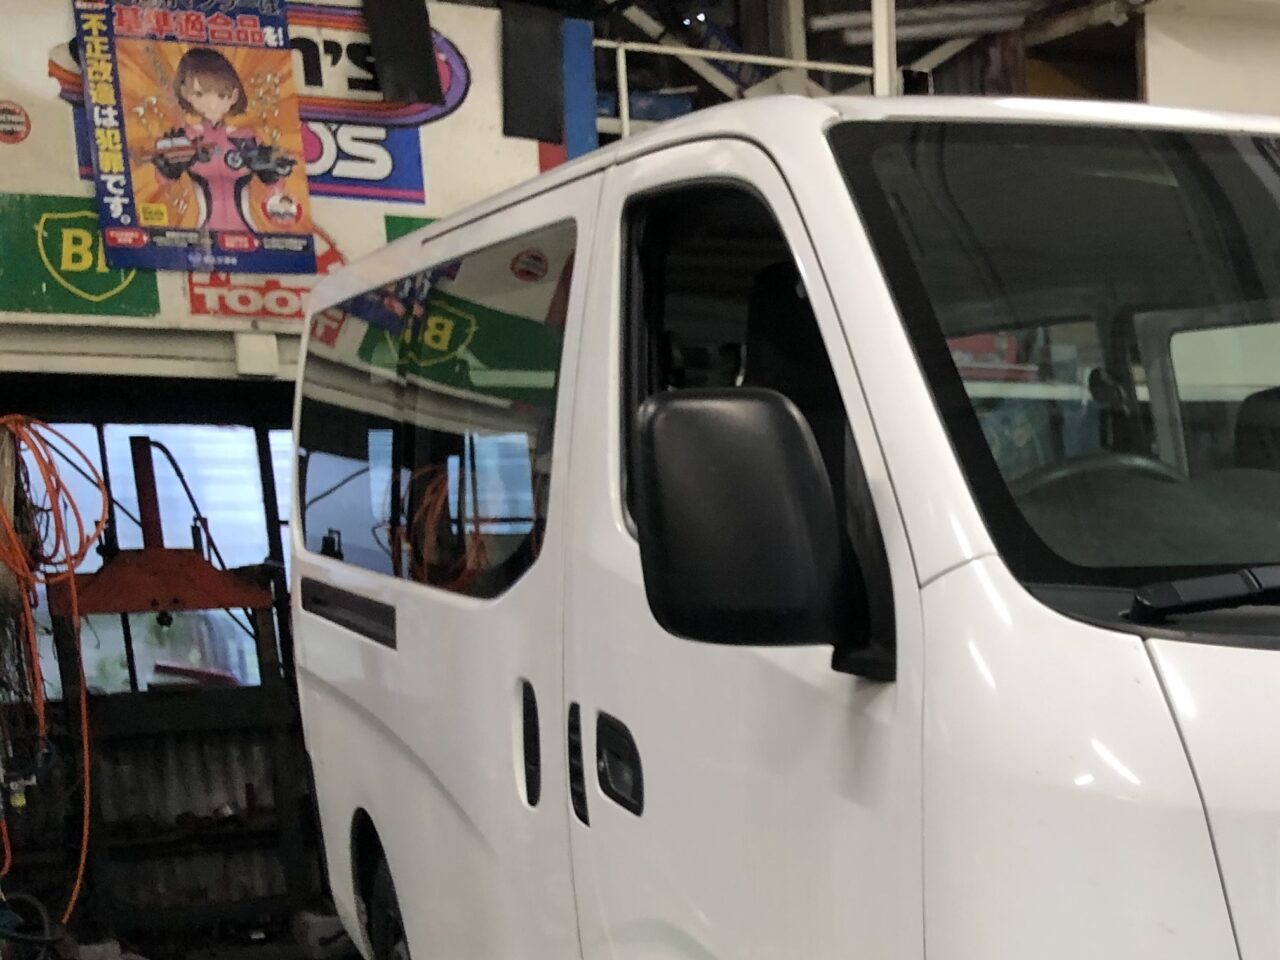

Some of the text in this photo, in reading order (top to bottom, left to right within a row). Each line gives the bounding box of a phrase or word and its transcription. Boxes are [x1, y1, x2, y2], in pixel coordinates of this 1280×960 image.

[80, 13, 132, 225] 不正改造は犯罪です。
[193, 286, 308, 317] TOO
